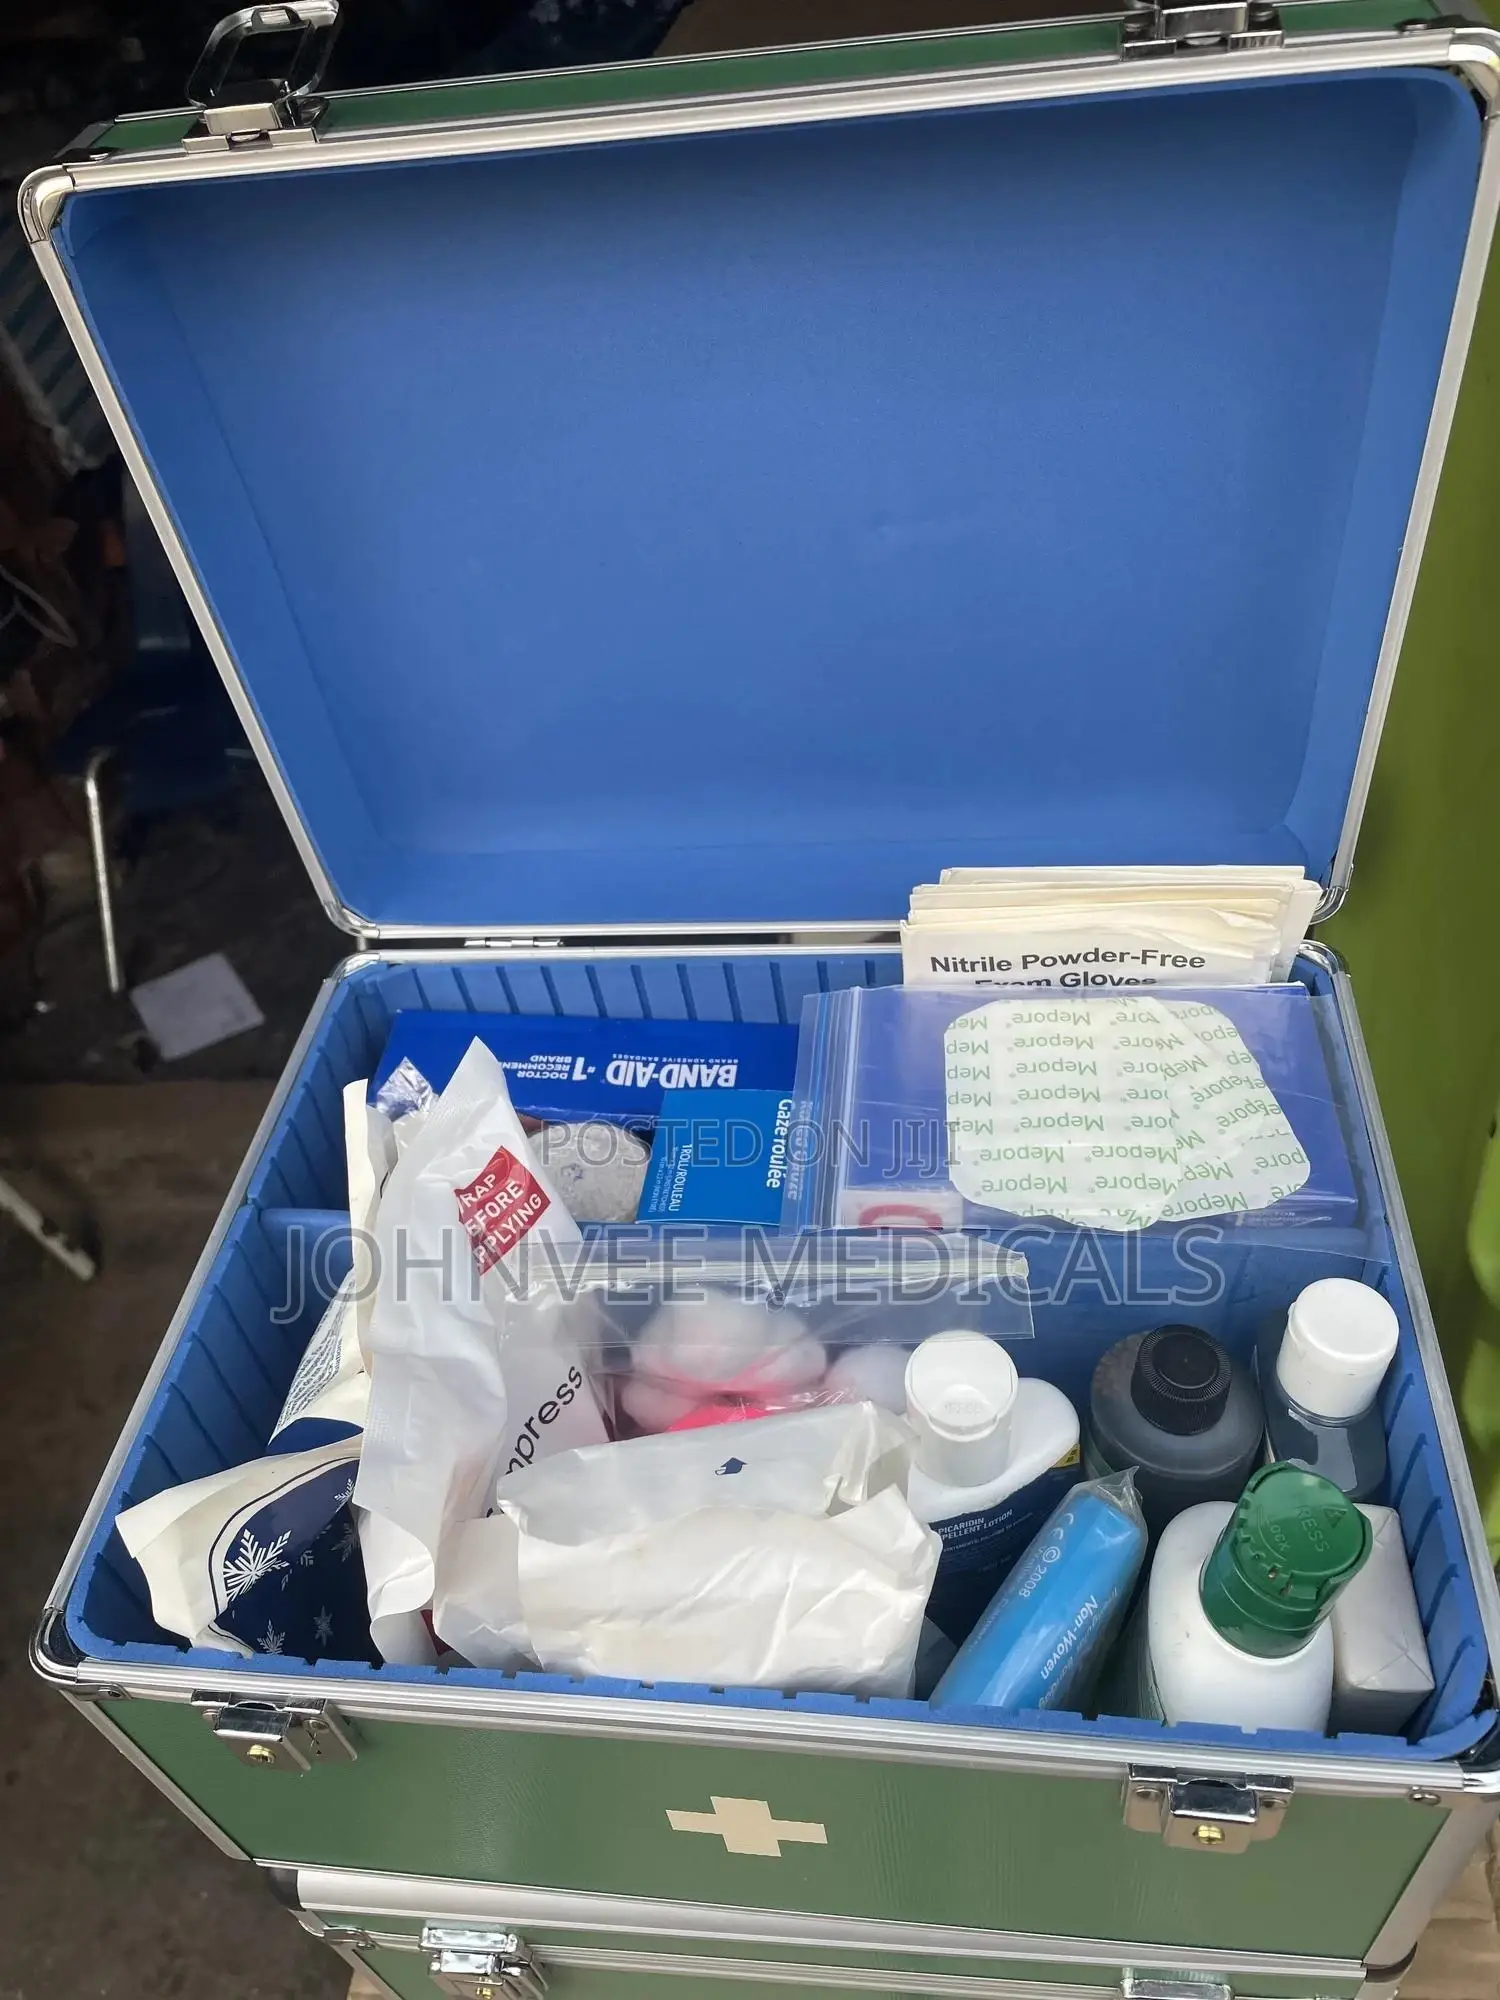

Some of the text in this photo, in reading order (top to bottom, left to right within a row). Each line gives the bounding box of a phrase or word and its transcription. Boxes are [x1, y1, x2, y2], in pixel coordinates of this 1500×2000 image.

[930, 947, 1206, 973] Nitrile Powder-Free
[1012, 1009, 1092, 1026] Mepore
[945, 1040, 989, 1055] Mep
[1013, 1033, 1094, 1050] Mepore
[500, 1061, 571, 1071] RECOMMEN
[530, 1055, 572, 1063] BRAND
[612, 1053, 659, 1062] BANDAGES
[1016, 1057, 1098, 1076] Mepore
[517, 1070, 569, 1080] DOCTOR
[605, 1059, 738, 1089] BAND-AID
[947, 1064, 991, 1080] Mep
[948, 1091, 992, 1107] Mep
[1018, 1083, 1100, 1103] Mepore
[1020, 1111, 1104, 1132] Mepore
[766, 1098, 794, 1189] Gaze roulée
[979, 1146, 1065, 1163] Mepore
[1091, 1145, 1178, 1165] Mepore
[457, 1173, 497, 1214] RAP
[981, 1173, 1068, 1195] Mepore
[464, 1179, 525, 1237] EFORE
[1162, 1192, 1249, 1217] Mepore
[472, 1192, 543, 1265] PPLYING
[937, 1517, 985, 1535] PICARIDIN
[940, 1525, 981, 1541] PELLENT
[983, 1508, 1013, 1530] LOTION
[1018, 1565, 1047, 1598] 2008
[1040, 1595, 1099, 1680] Non-Woven
